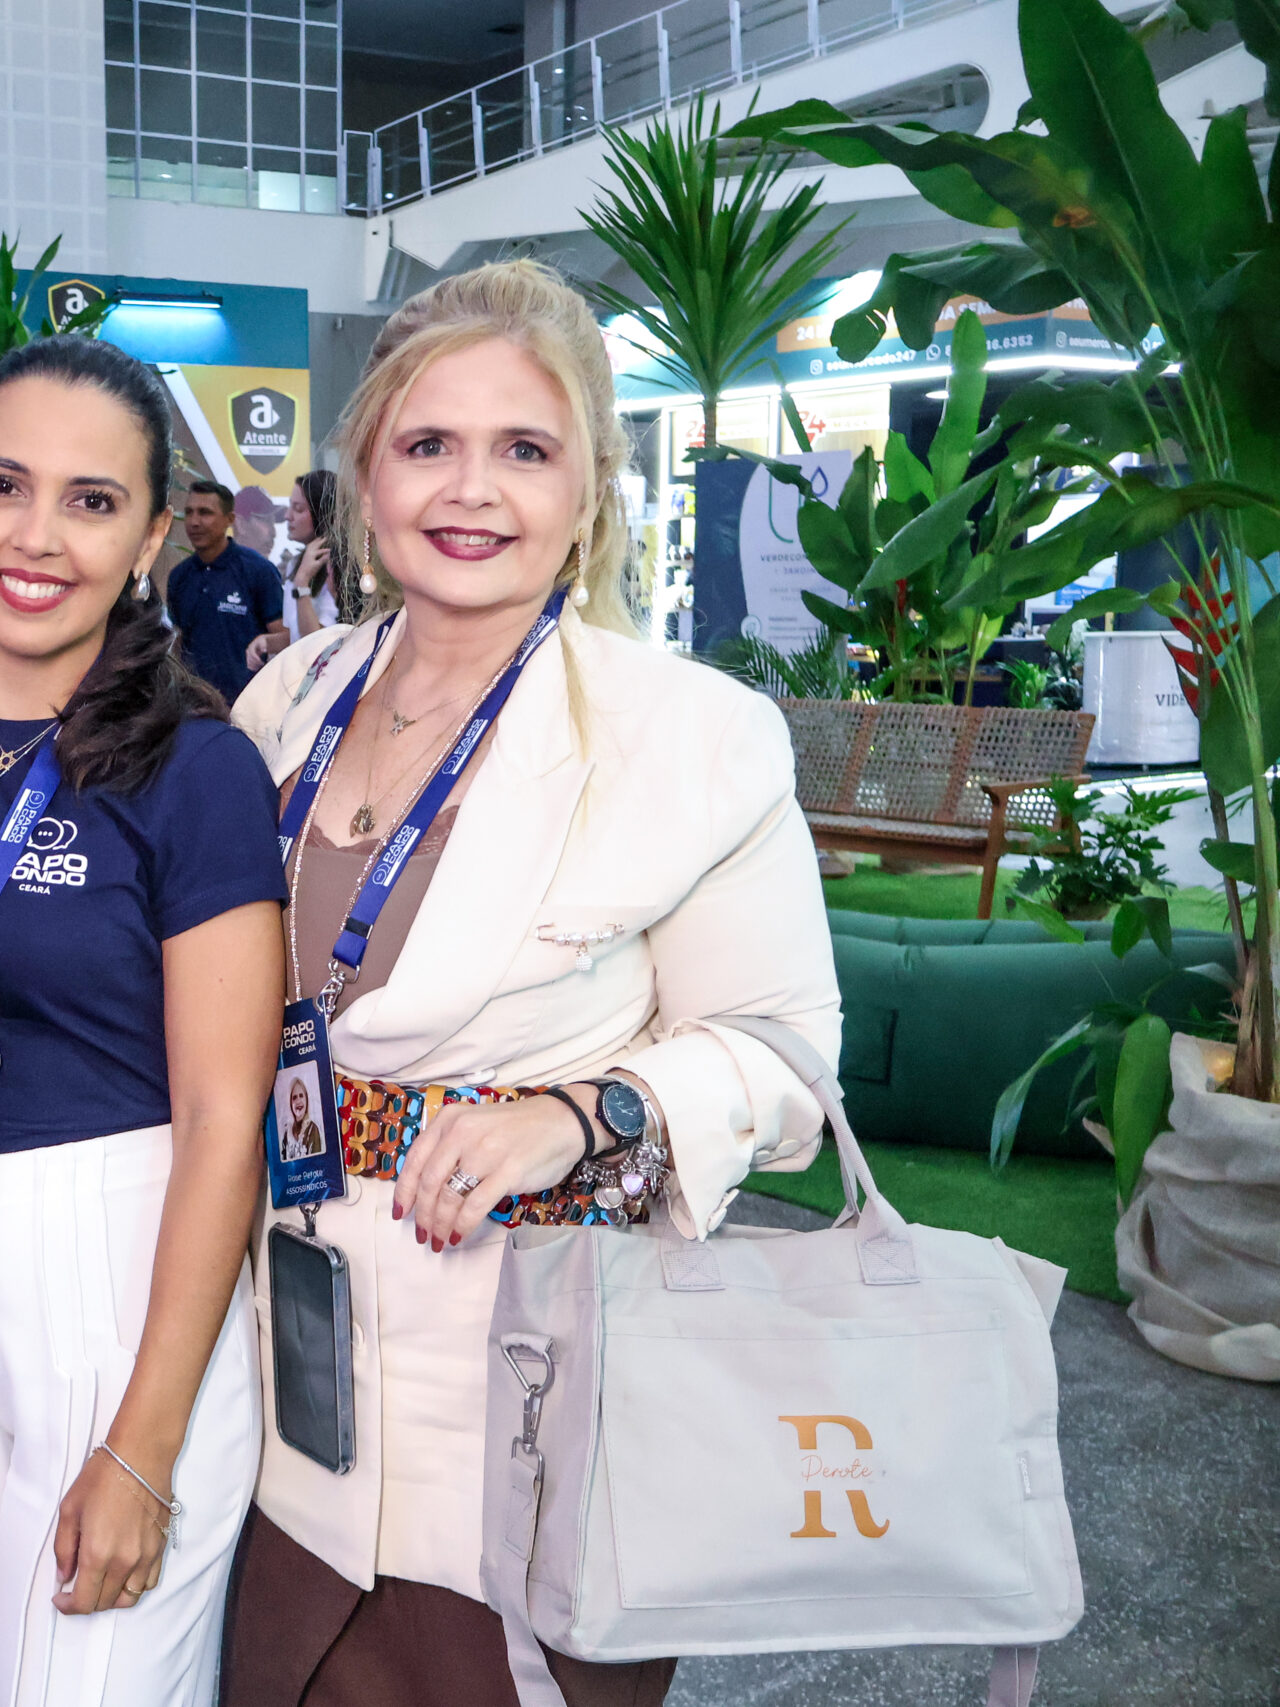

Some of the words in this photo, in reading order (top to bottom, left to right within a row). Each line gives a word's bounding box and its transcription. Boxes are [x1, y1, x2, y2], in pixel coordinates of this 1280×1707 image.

[243, 431, 287, 445] Atente
[311, 725, 331, 762] PAPO
[8, 808, 29, 842] CONDO
[14, 810, 37, 843] PAPO
[383, 825, 410, 862] PAPO
[389, 826, 415, 864] CONDO
[16, 852, 88, 873] APO
[11, 865, 86, 886] ONDO
[19, 884, 50, 895] CEARÁ
[283, 1020, 314, 1039] PAPO
[285, 1032, 315, 1048] CONDO
